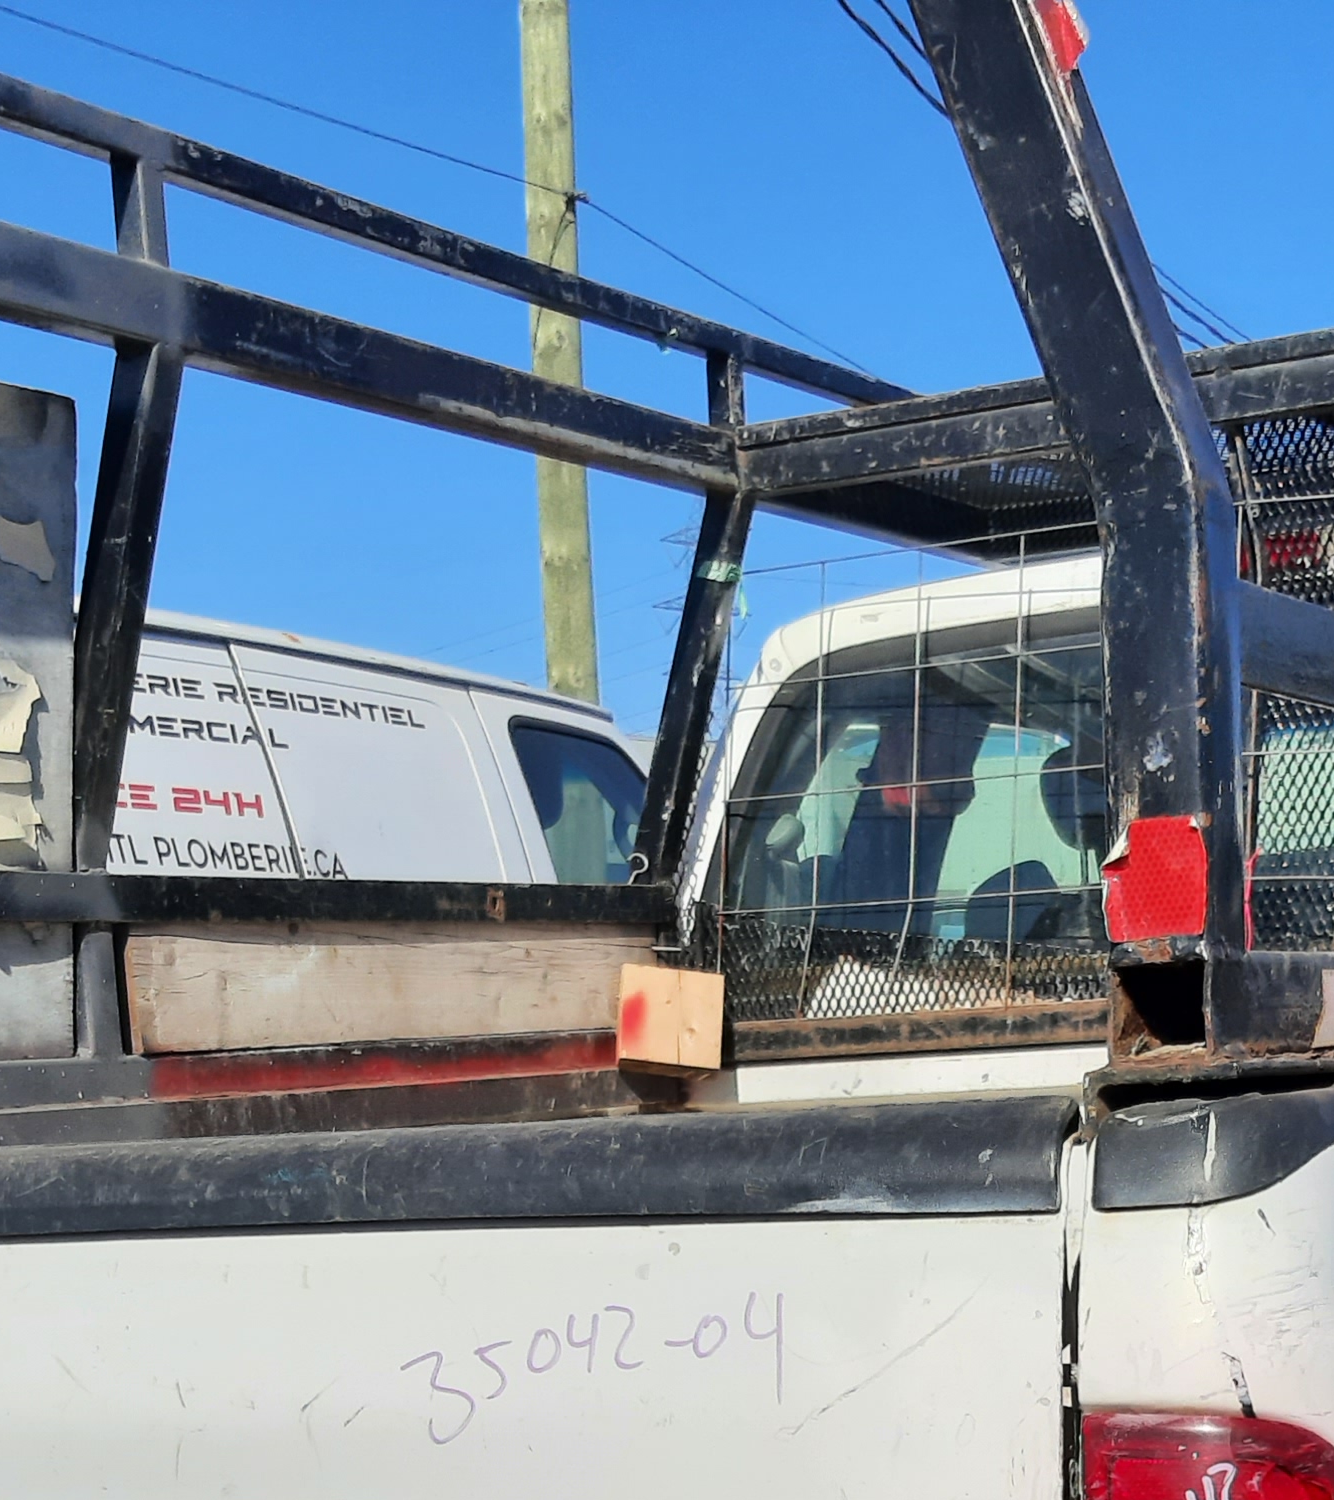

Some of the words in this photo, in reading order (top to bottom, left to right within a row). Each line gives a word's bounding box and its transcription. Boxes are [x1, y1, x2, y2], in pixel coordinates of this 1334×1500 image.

[212, 680, 427, 730] RESIDENTIEL
[171, 786, 266, 819] 24H
[109, 832, 149, 867] TL
[399, 1290, 786, 1446] 35042-04
